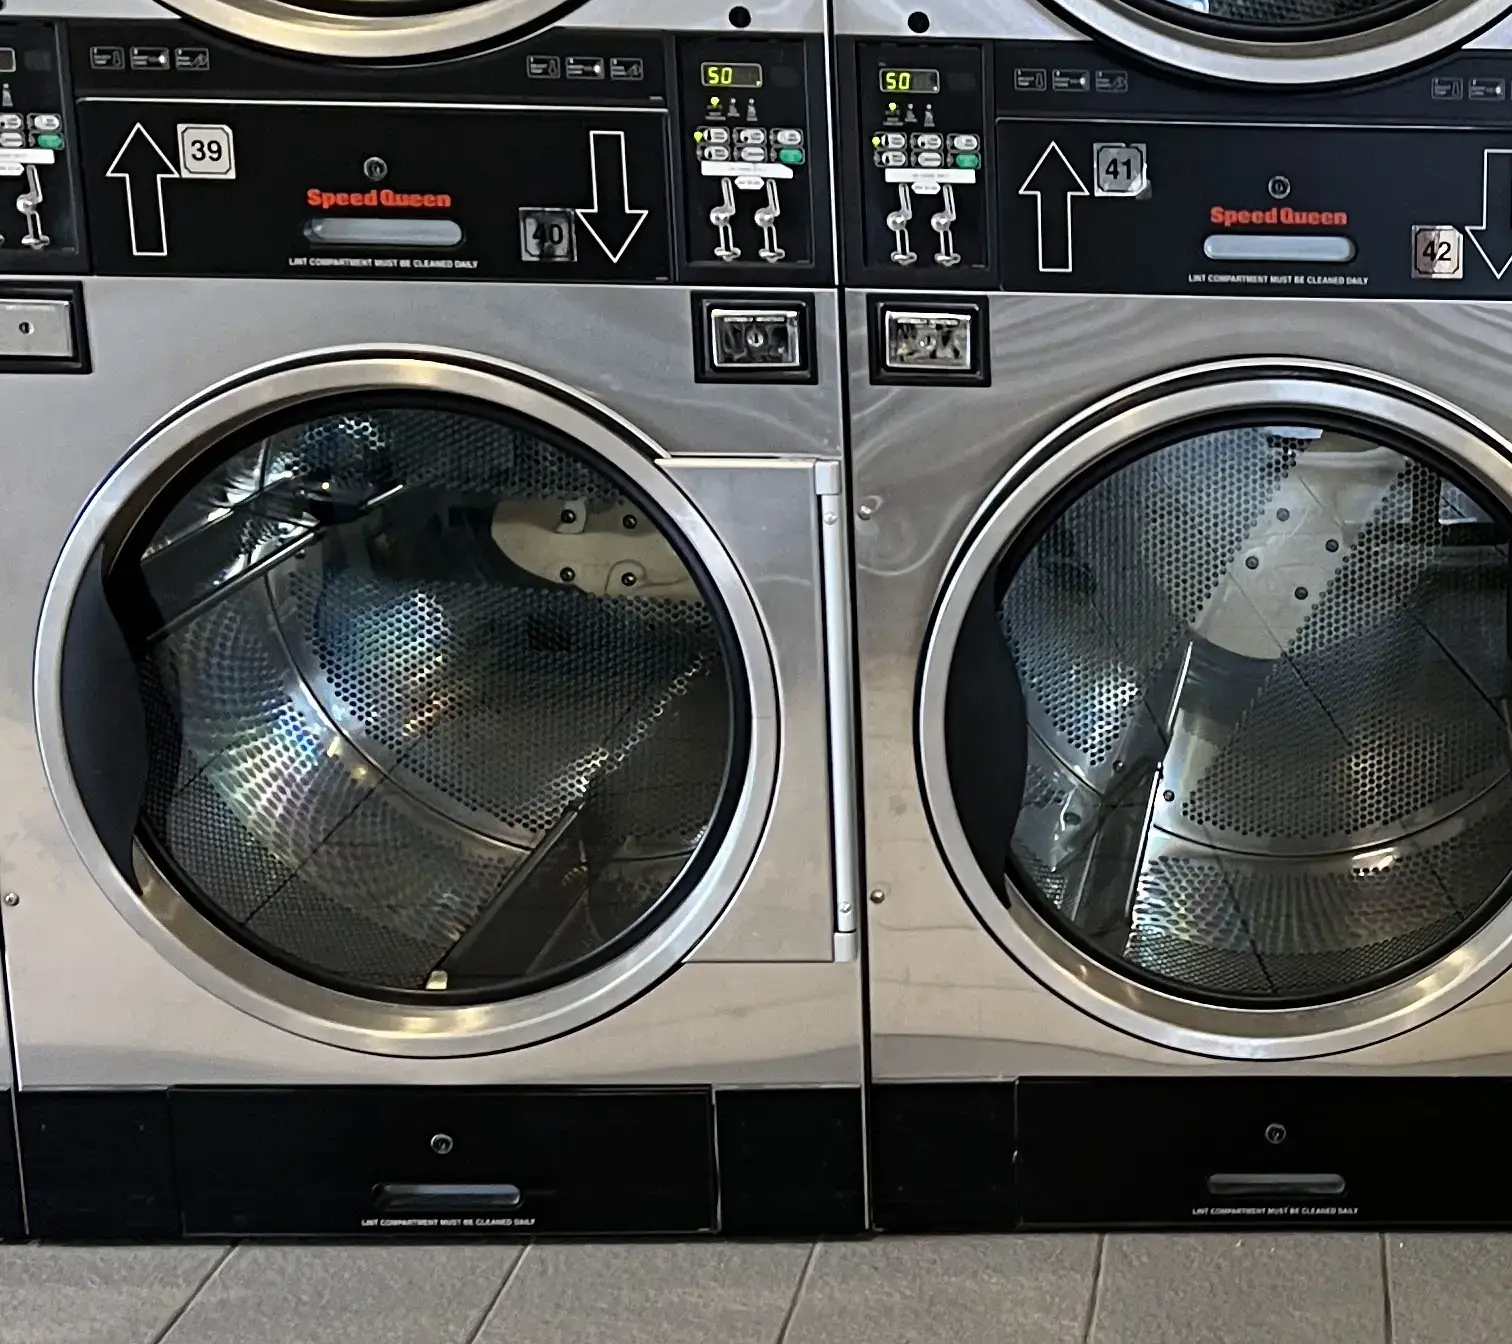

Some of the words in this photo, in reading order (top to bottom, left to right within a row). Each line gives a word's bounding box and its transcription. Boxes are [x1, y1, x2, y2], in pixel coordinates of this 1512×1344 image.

[707, 66, 733, 85] 50
[885, 72, 911, 90] 50
[189, 139, 223, 162] 39
[1104, 158, 1133, 181] 41
[307, 188, 378, 209] Speed
[380, 189, 451, 207] Queen
[1210, 206, 1277, 227] Speed
[1280, 207, 1347, 225] Queen
[532, 223, 564, 247] 40
[1421, 240, 1452, 263] 42
